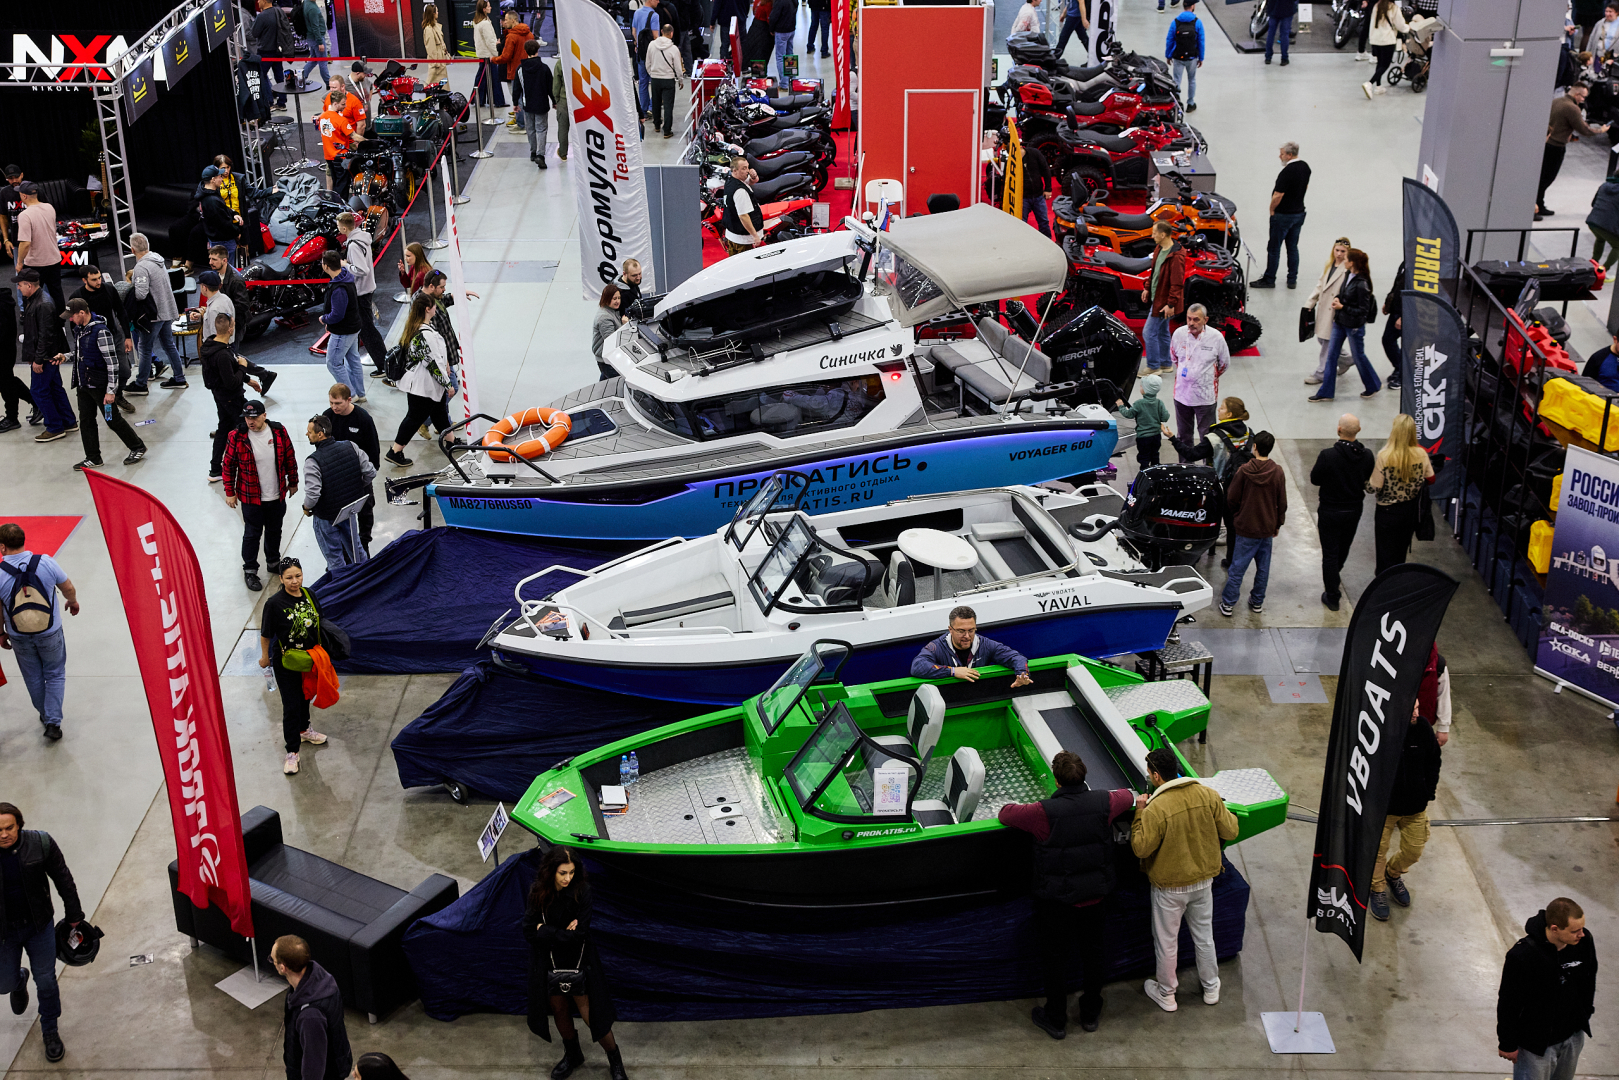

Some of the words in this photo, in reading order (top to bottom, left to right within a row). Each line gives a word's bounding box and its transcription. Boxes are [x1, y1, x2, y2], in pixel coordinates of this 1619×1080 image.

[613, 133, 630, 182] Team
[586, 128, 622, 285] Формула
[60, 250, 89, 266] XM
[819, 347, 886, 370] Синичка
[1056, 344, 1103, 363] MERCURY
[1009, 443, 1067, 461] VOYAGER
[1071, 439, 1093, 451] 600
[803, 482, 856, 498] КТИВНОГО
[860, 474, 900, 488] ОТДЫХА
[449, 497, 533, 510] MA8276RUS50
[801, 489, 874, 511] ATIS.RU
[1550, 621, 1595, 647] GKA-DOCKS
[1561, 644, 1591, 663] GKA
[1346, 612, 1407, 815] VBOATS
[856, 827, 917, 838] PROKATIS.ru
